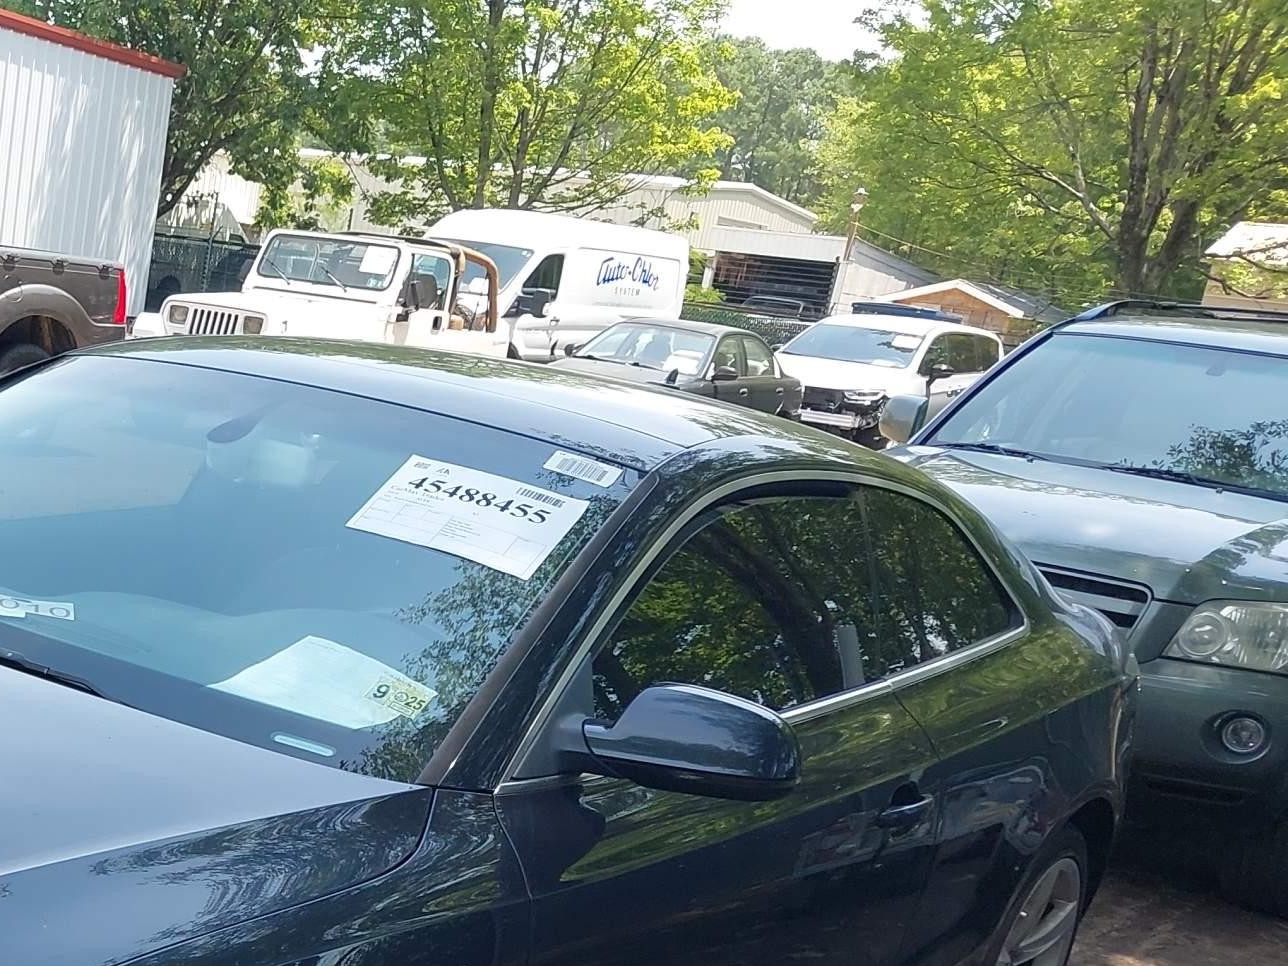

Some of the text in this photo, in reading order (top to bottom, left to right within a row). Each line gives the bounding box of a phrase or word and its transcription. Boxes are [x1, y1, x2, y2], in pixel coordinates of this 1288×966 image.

[408, 476, 552, 524] 45488455
[373, 684, 390, 698] 9
[404, 696, 426, 711] 25
